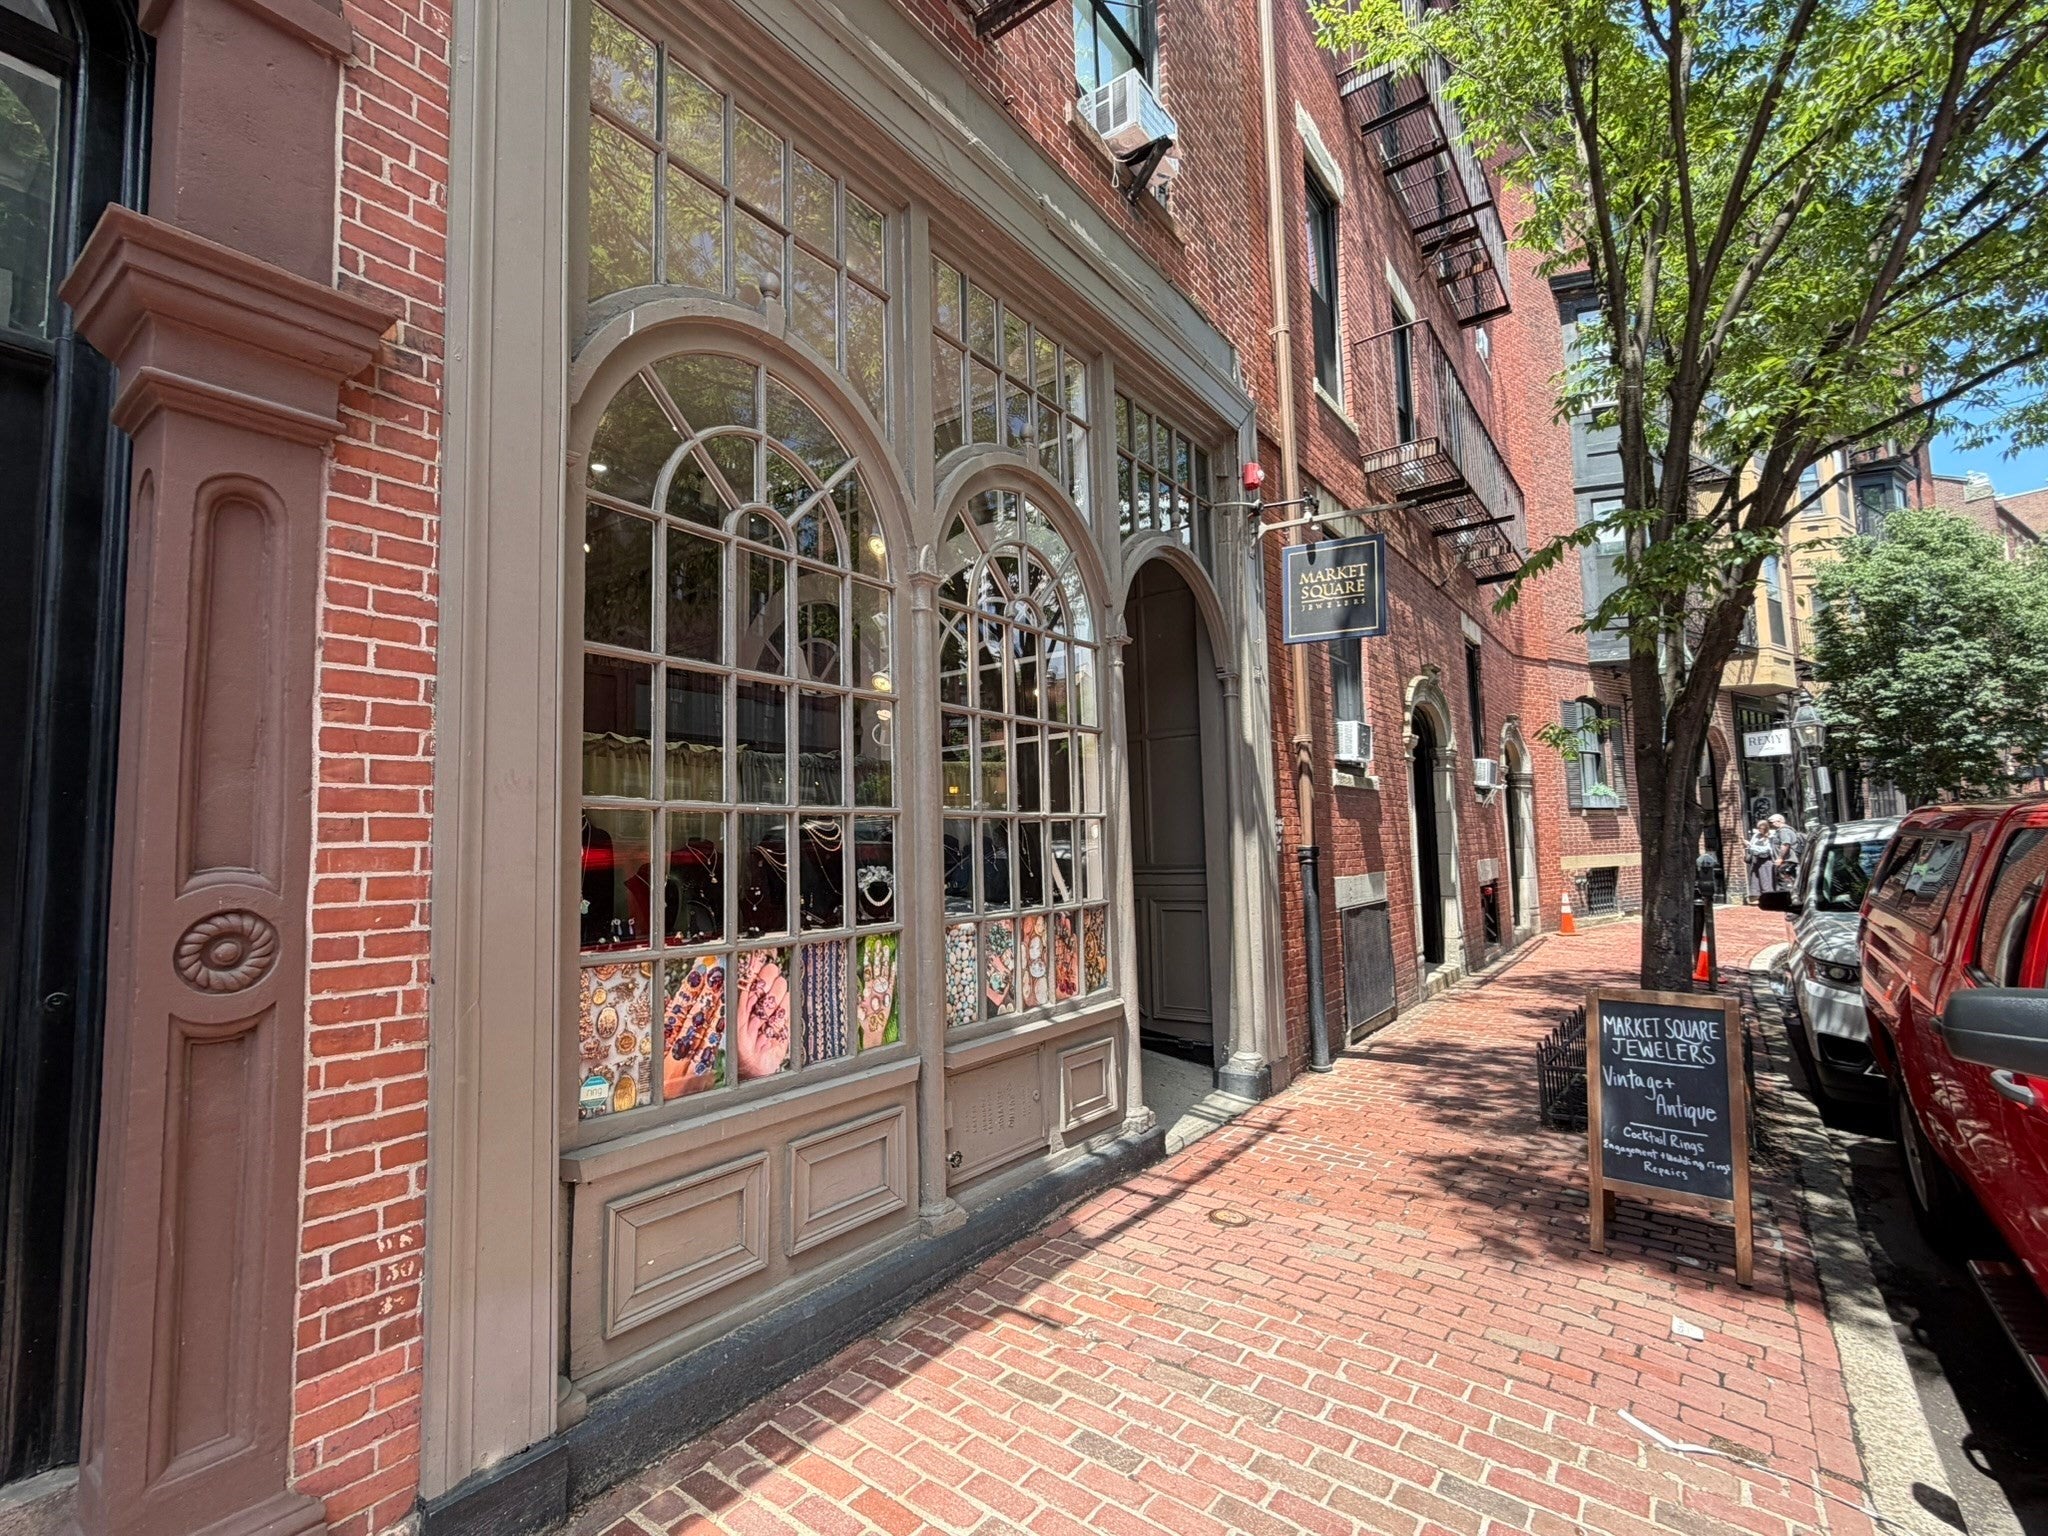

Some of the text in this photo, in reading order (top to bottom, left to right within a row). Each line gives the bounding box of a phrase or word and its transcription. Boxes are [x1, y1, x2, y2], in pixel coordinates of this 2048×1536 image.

[1299, 563, 1368, 585] MARKET
[1301, 579, 1365, 600] SQUARE
[1301, 597, 1366, 612] JEWELERS
[1602, 1015, 1720, 1045] MARKET SQUARE
[1612, 1037, 1716, 1065] JEWELERS
[1656, 1094, 1717, 1127] Antique
[1623, 1126, 1705, 1156] Cocktail Rings
[1643, 1161, 1688, 1180] Repairs
